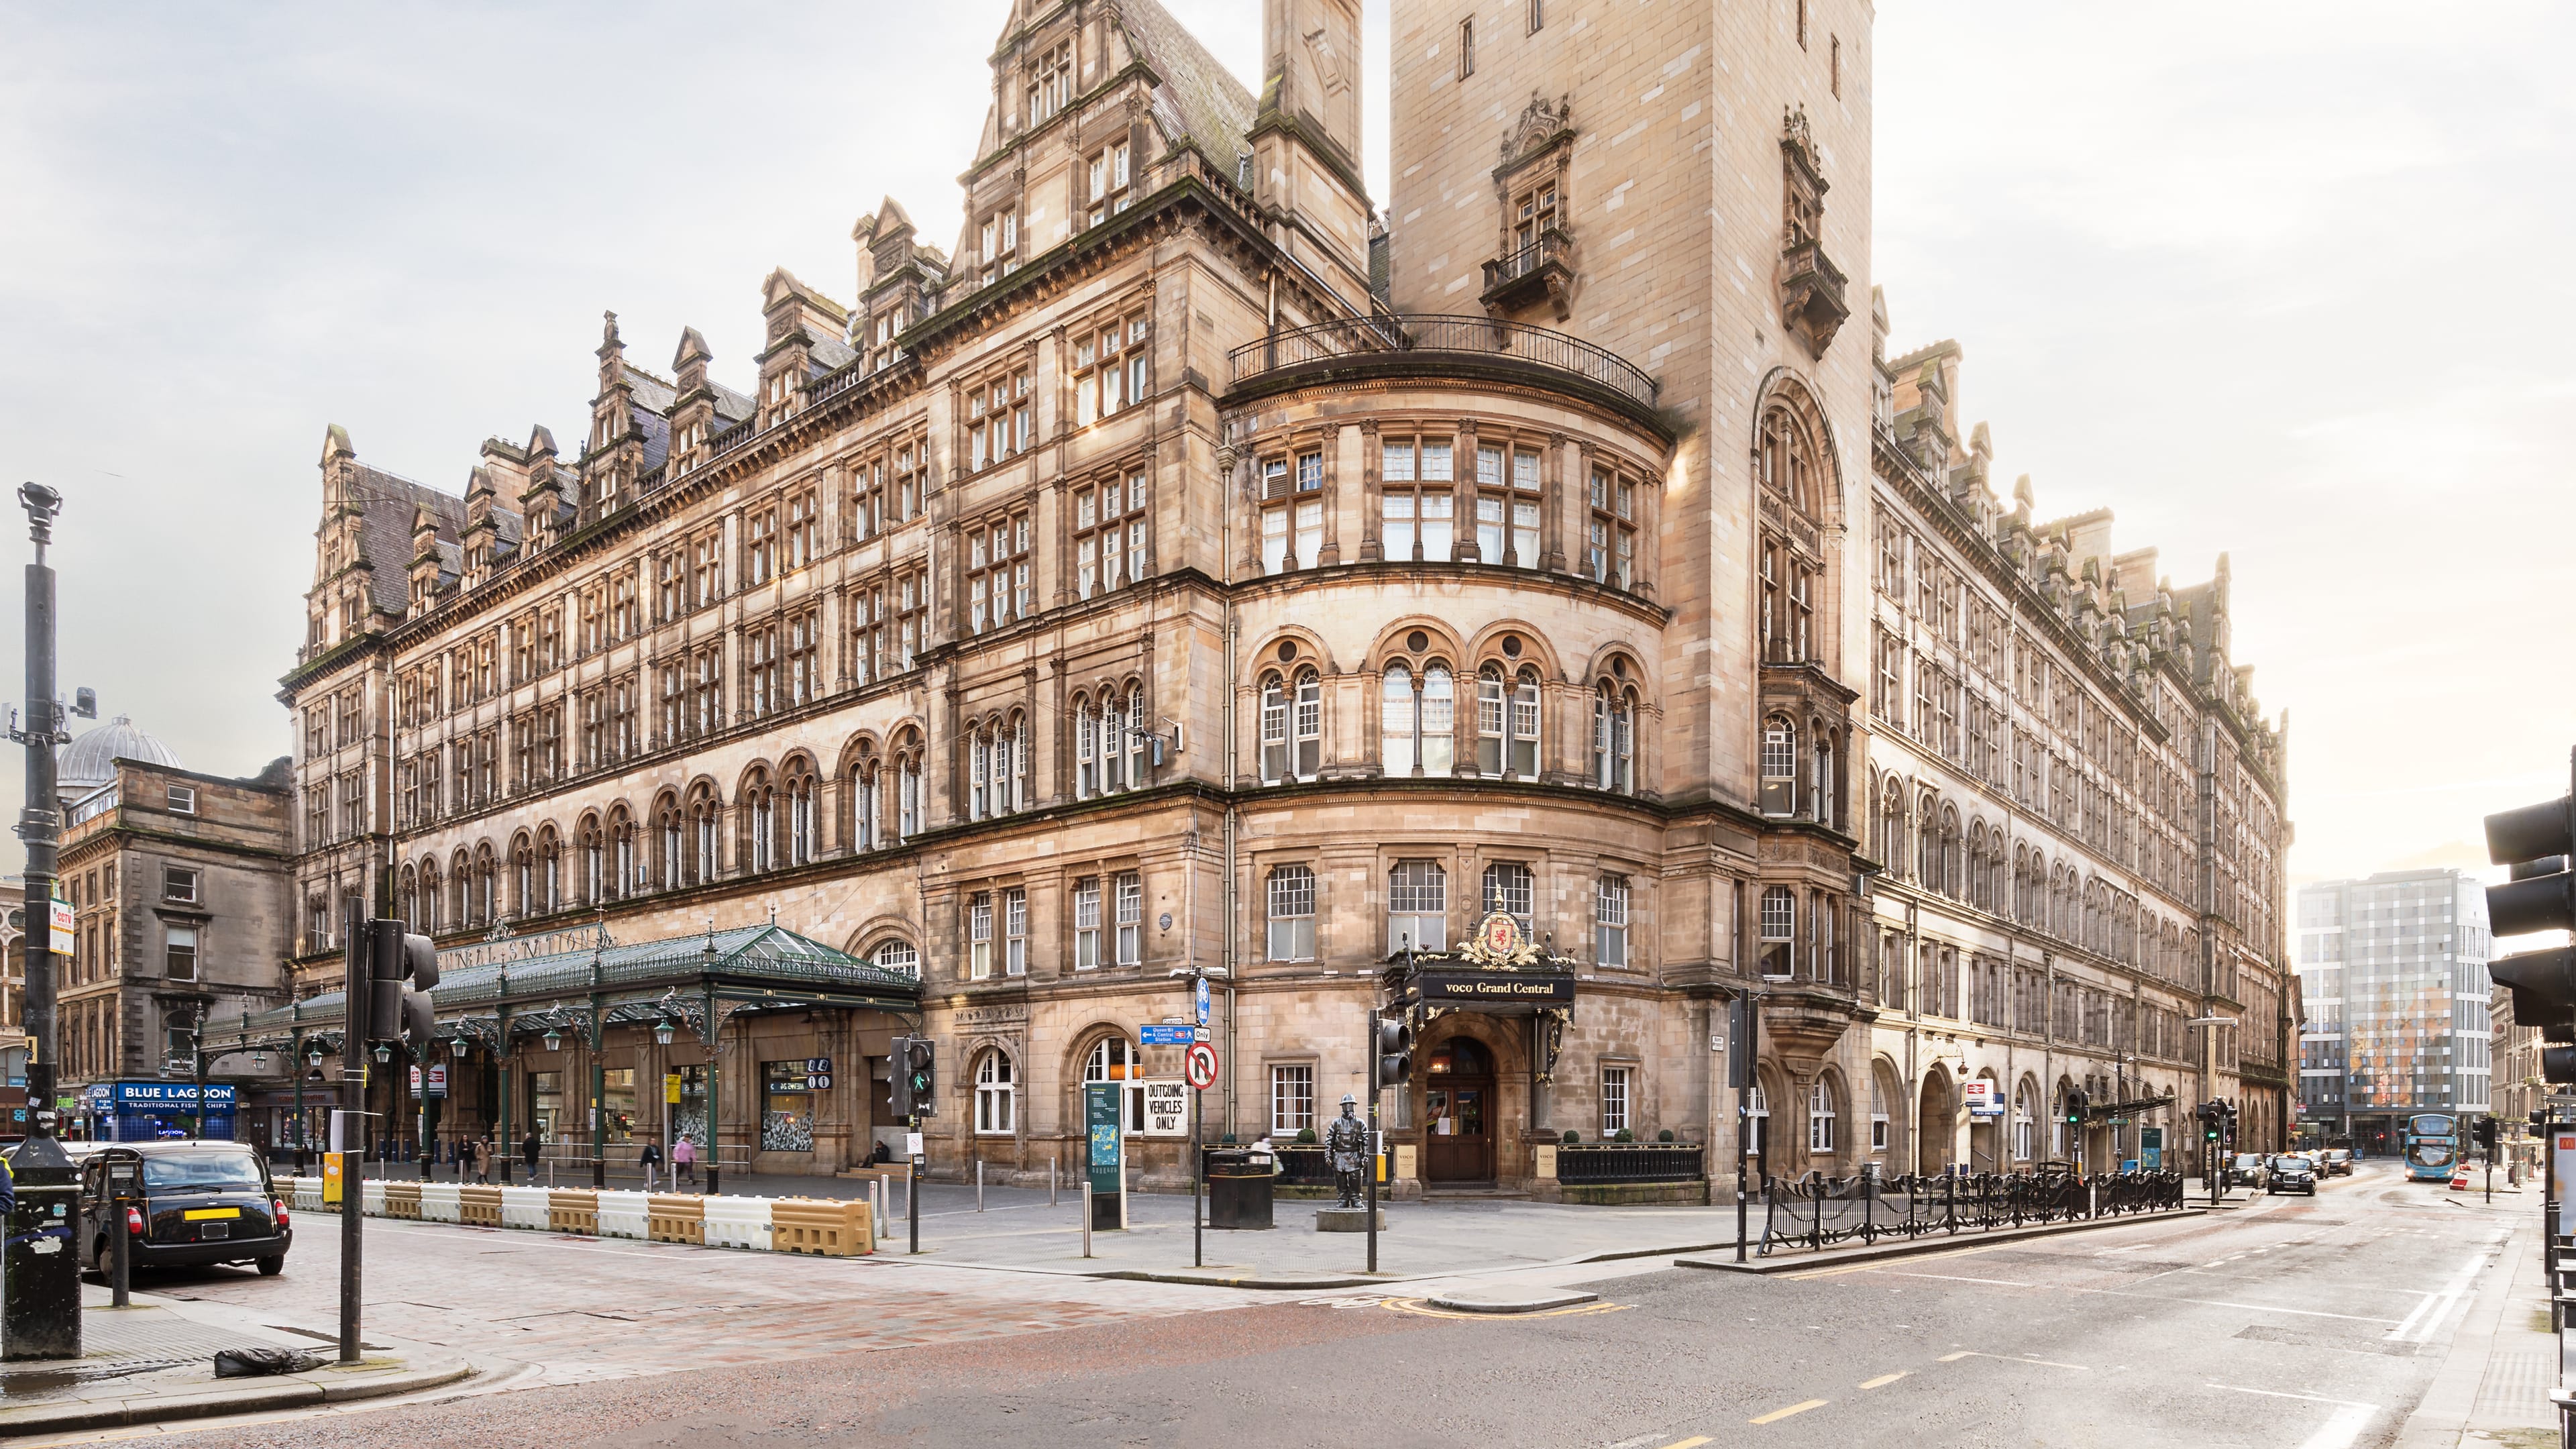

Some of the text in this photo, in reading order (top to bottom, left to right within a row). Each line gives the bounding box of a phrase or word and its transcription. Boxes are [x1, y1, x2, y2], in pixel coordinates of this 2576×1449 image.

[58, 912, 72, 924] CCTV
[436, 928, 589, 972] ENTRAL STATION
[1446, 982, 1553, 994] voco Grand Central
[1199, 1006, 1208, 1020] taxi
[1196, 1030, 1209, 1039] Only
[125, 1087, 161, 1097] BLUE
[1148, 1084, 1183, 1097] OUTGOING
[1148, 1100, 1183, 1114] VEHICLES
[1156, 1116, 1176, 1130] ONLY
